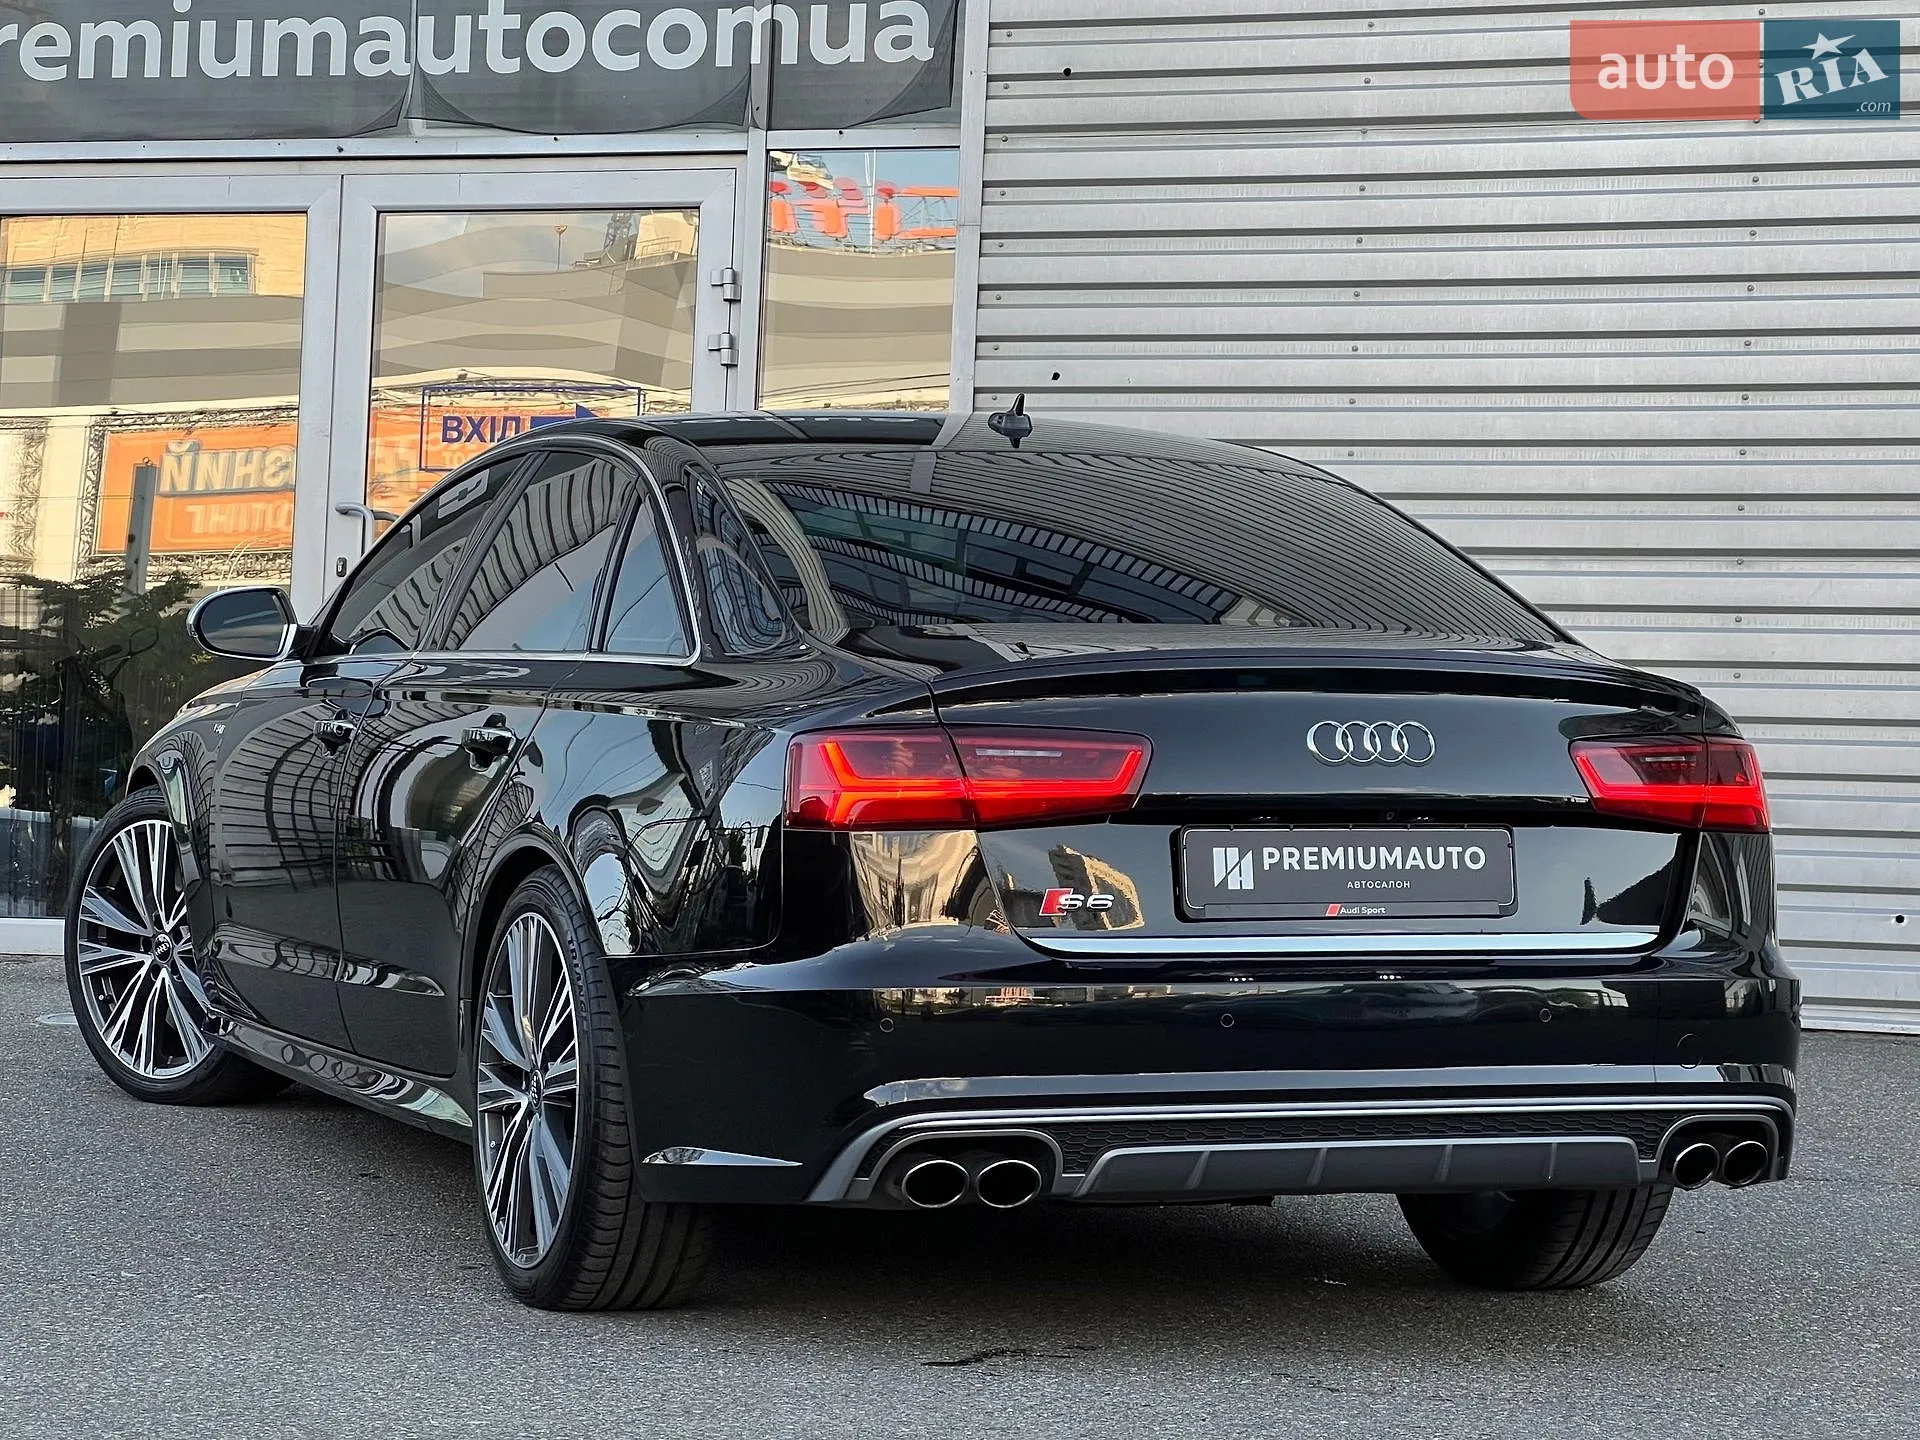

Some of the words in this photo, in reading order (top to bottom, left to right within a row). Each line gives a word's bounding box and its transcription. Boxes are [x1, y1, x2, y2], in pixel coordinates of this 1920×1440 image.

[441, 415, 521, 443] ВХІД
[1262, 846, 1487, 871] PREMIUMAUTO
[1346, 880, 1411, 889] АВТОСАЛОН
[1056, 893, 1115, 911] S6
[1340, 906, 1360, 914] Audi
[1361, 906, 1386, 916] Sport
